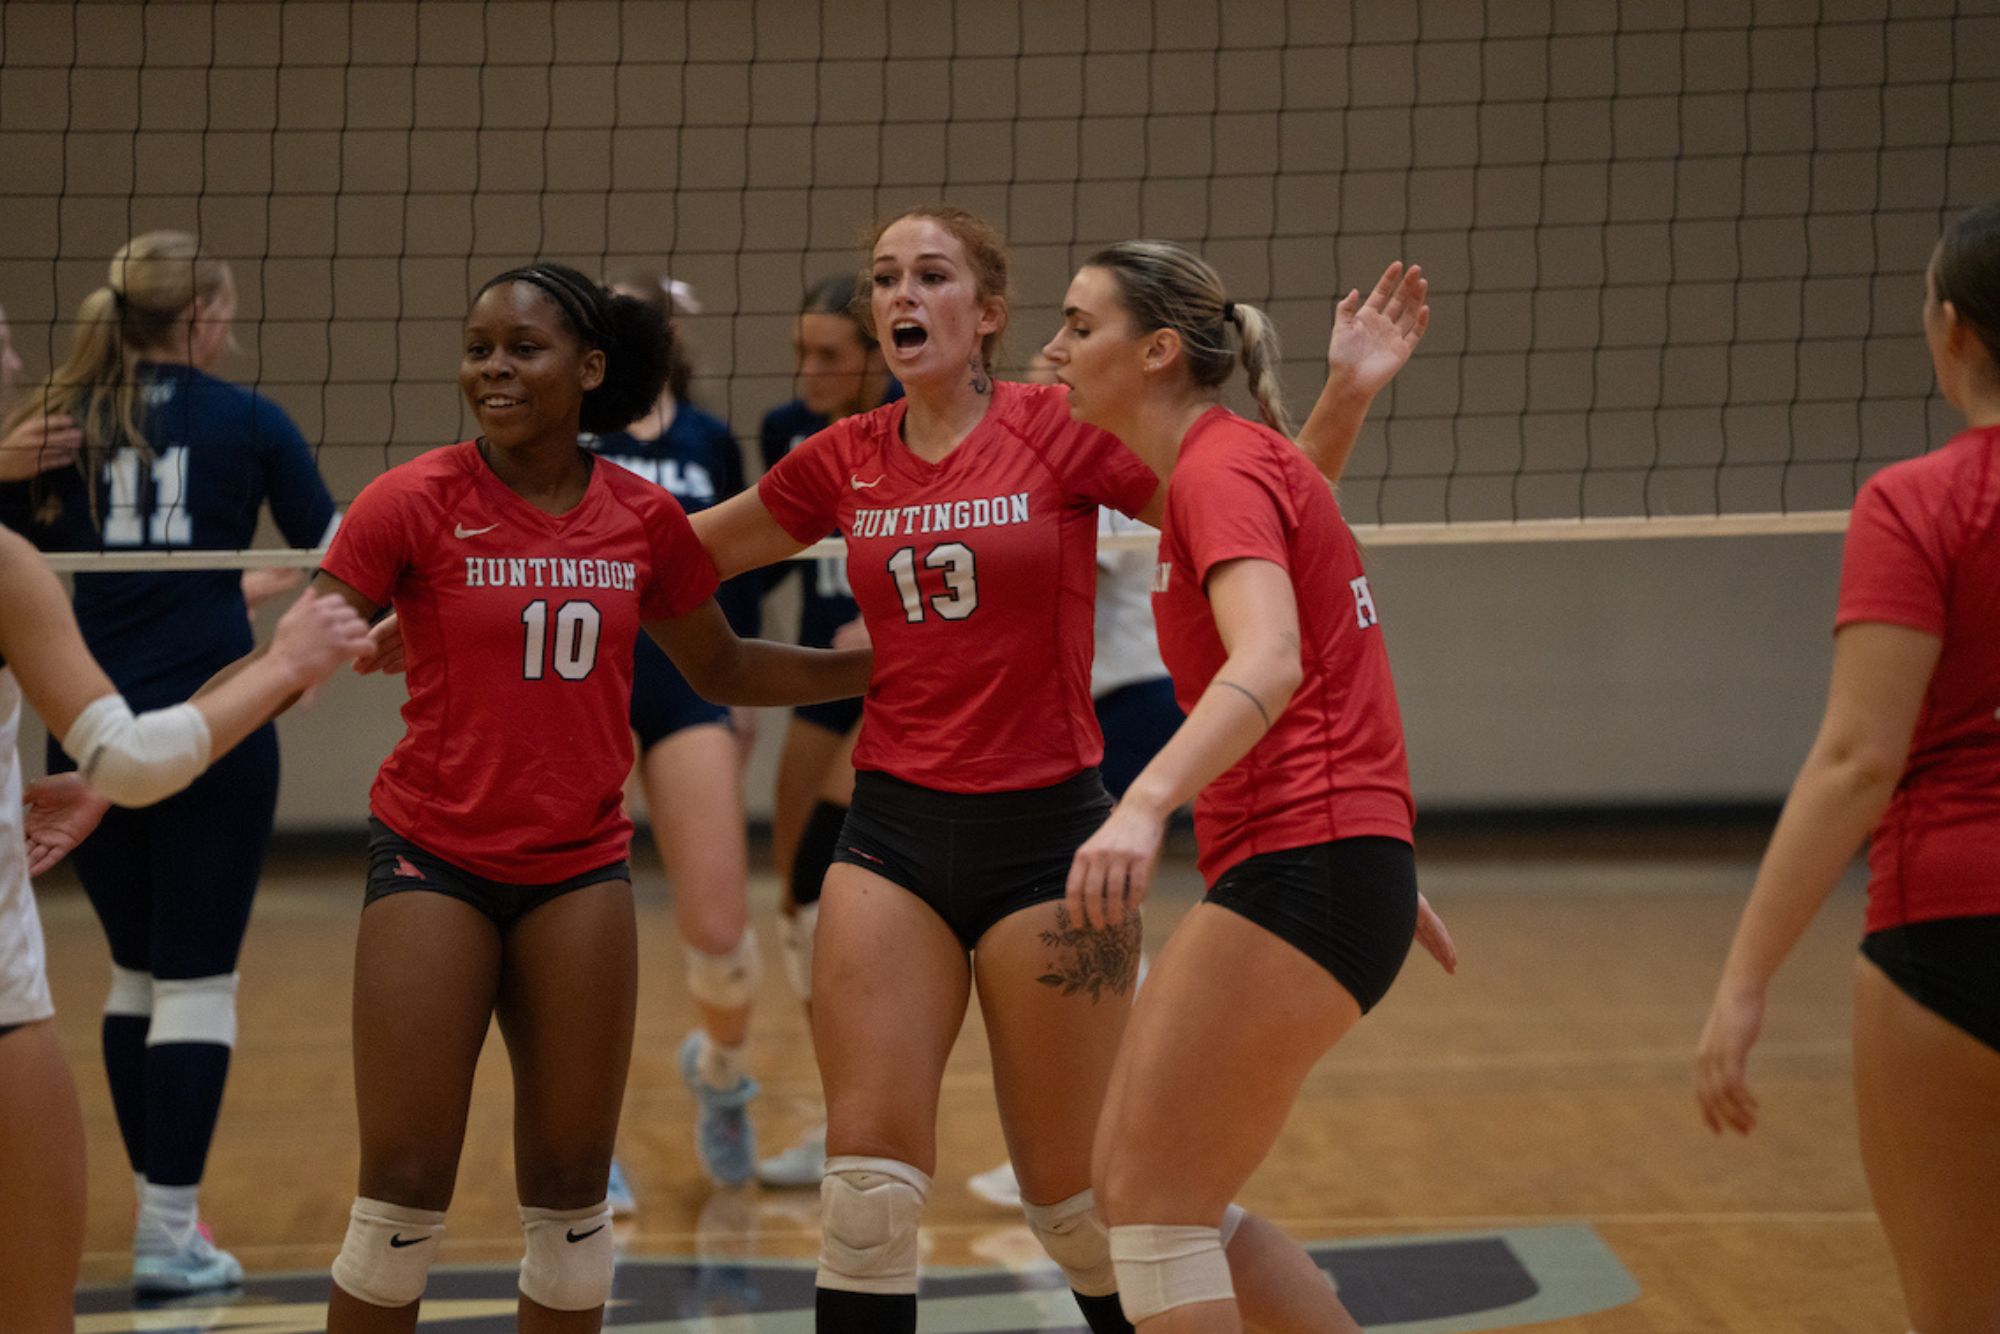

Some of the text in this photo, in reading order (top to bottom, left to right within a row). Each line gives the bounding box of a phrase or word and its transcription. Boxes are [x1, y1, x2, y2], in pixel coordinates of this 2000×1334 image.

[103, 446, 192, 546] 11
[852, 492, 1029, 538] HUNTINGDON
[465, 557, 636, 591] HUNTINGDON
[887, 541, 979, 623] 13
[521, 599, 602, 682] 10
